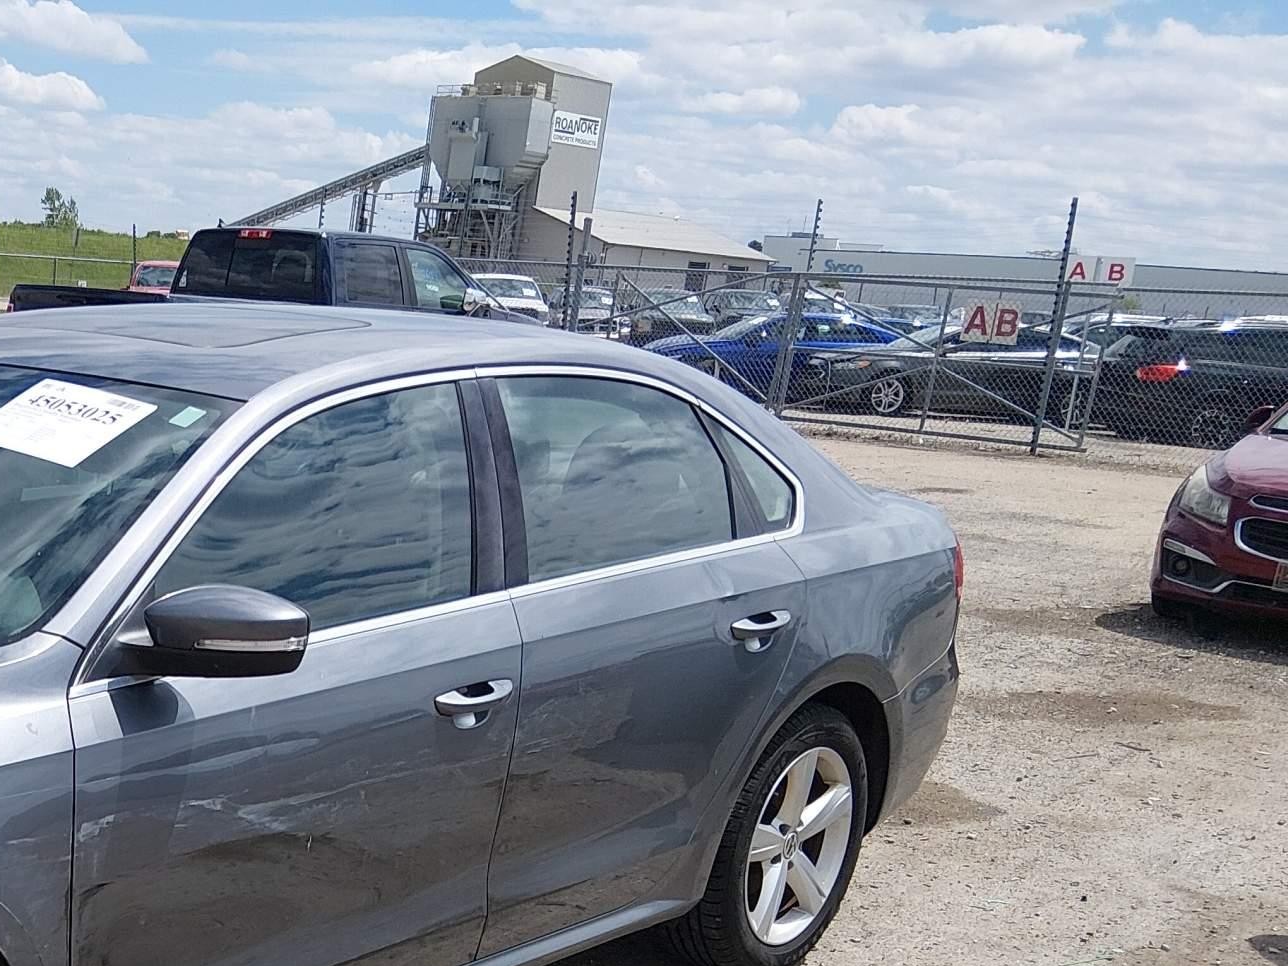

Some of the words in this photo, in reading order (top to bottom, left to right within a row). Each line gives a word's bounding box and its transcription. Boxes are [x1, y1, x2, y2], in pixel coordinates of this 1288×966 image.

[555, 116, 599, 135] ROANOKE
[823, 259, 863, 273] Sysco
[1069, 262, 1086, 280] A
[1108, 263, 1125, 281] B
[28, 394, 123, 425] 45053025
